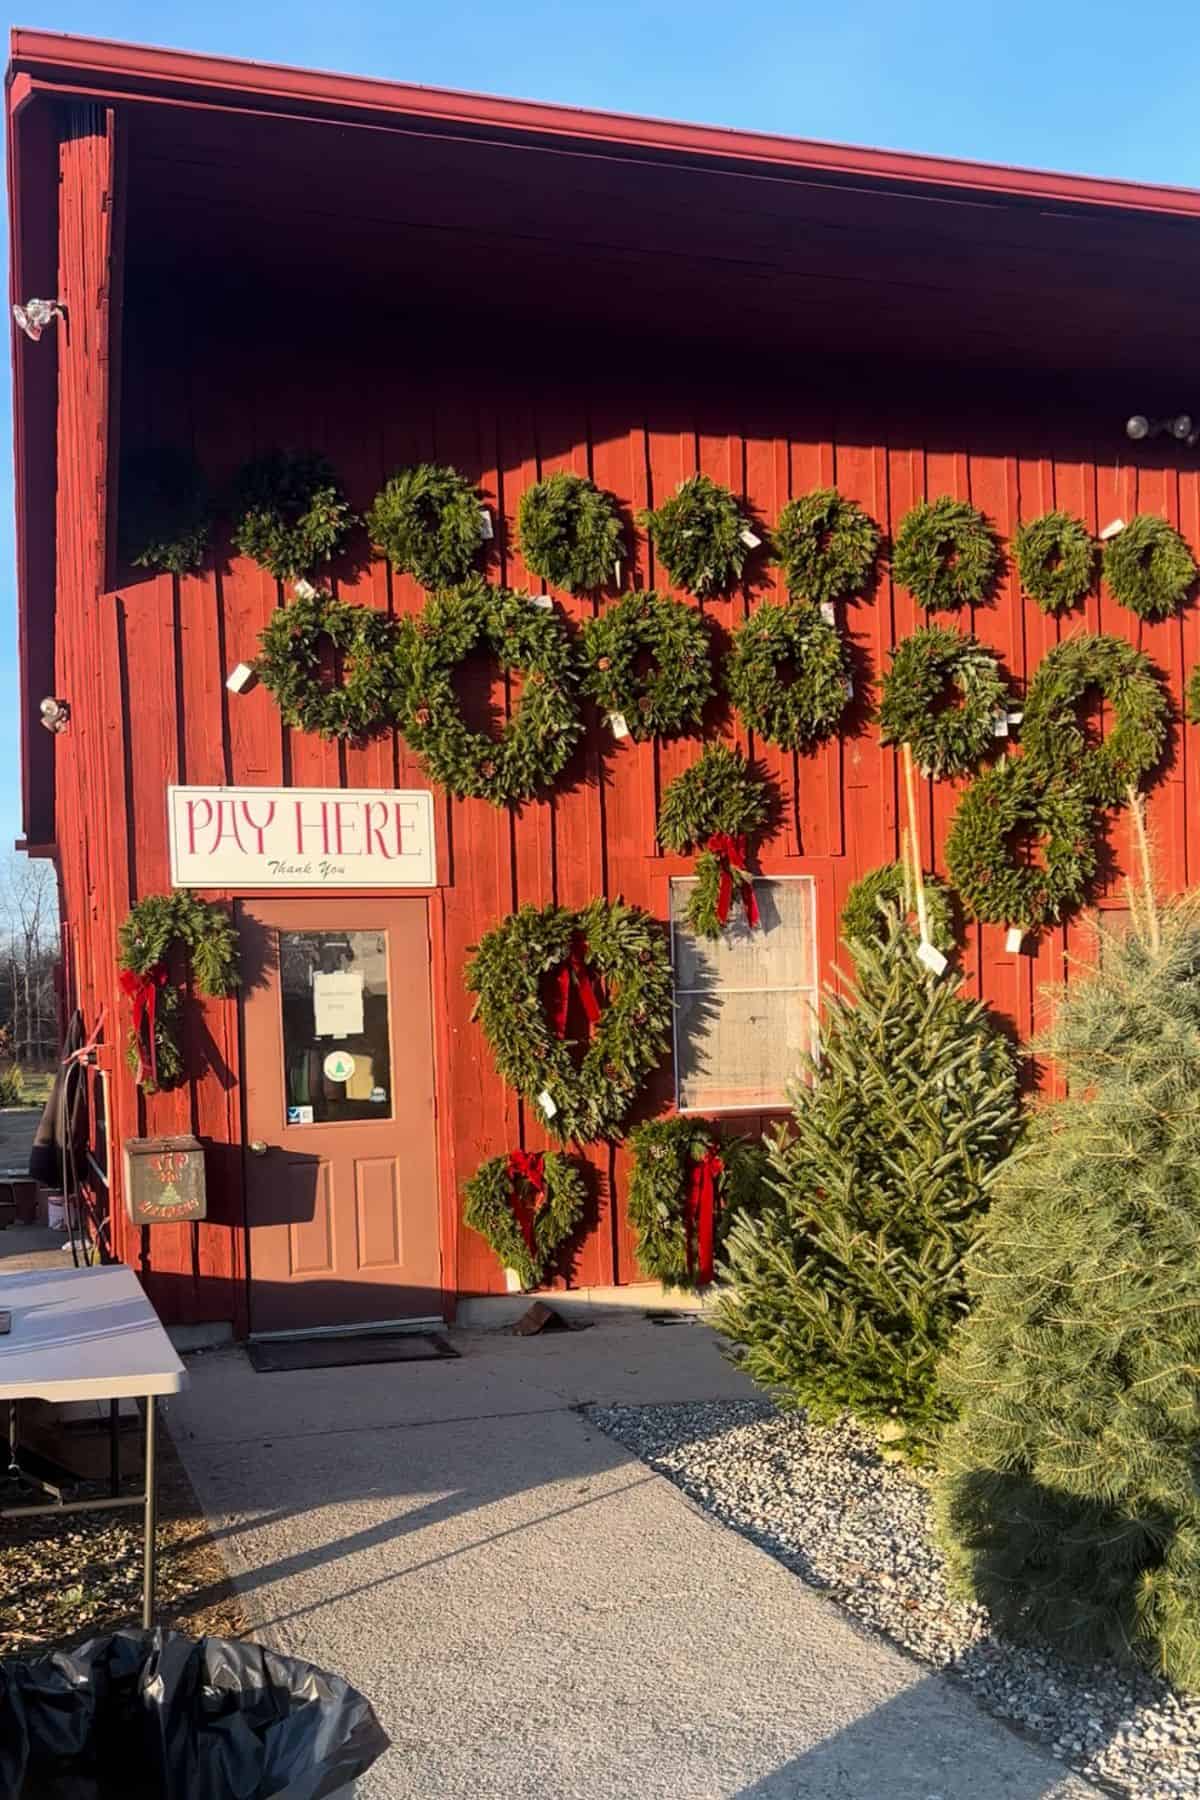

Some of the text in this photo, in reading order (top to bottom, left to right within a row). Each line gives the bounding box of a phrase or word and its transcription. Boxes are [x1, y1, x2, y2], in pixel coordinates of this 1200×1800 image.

[185, 798, 421, 859] PAY HERE
[267, 860, 345, 878] Thank You
